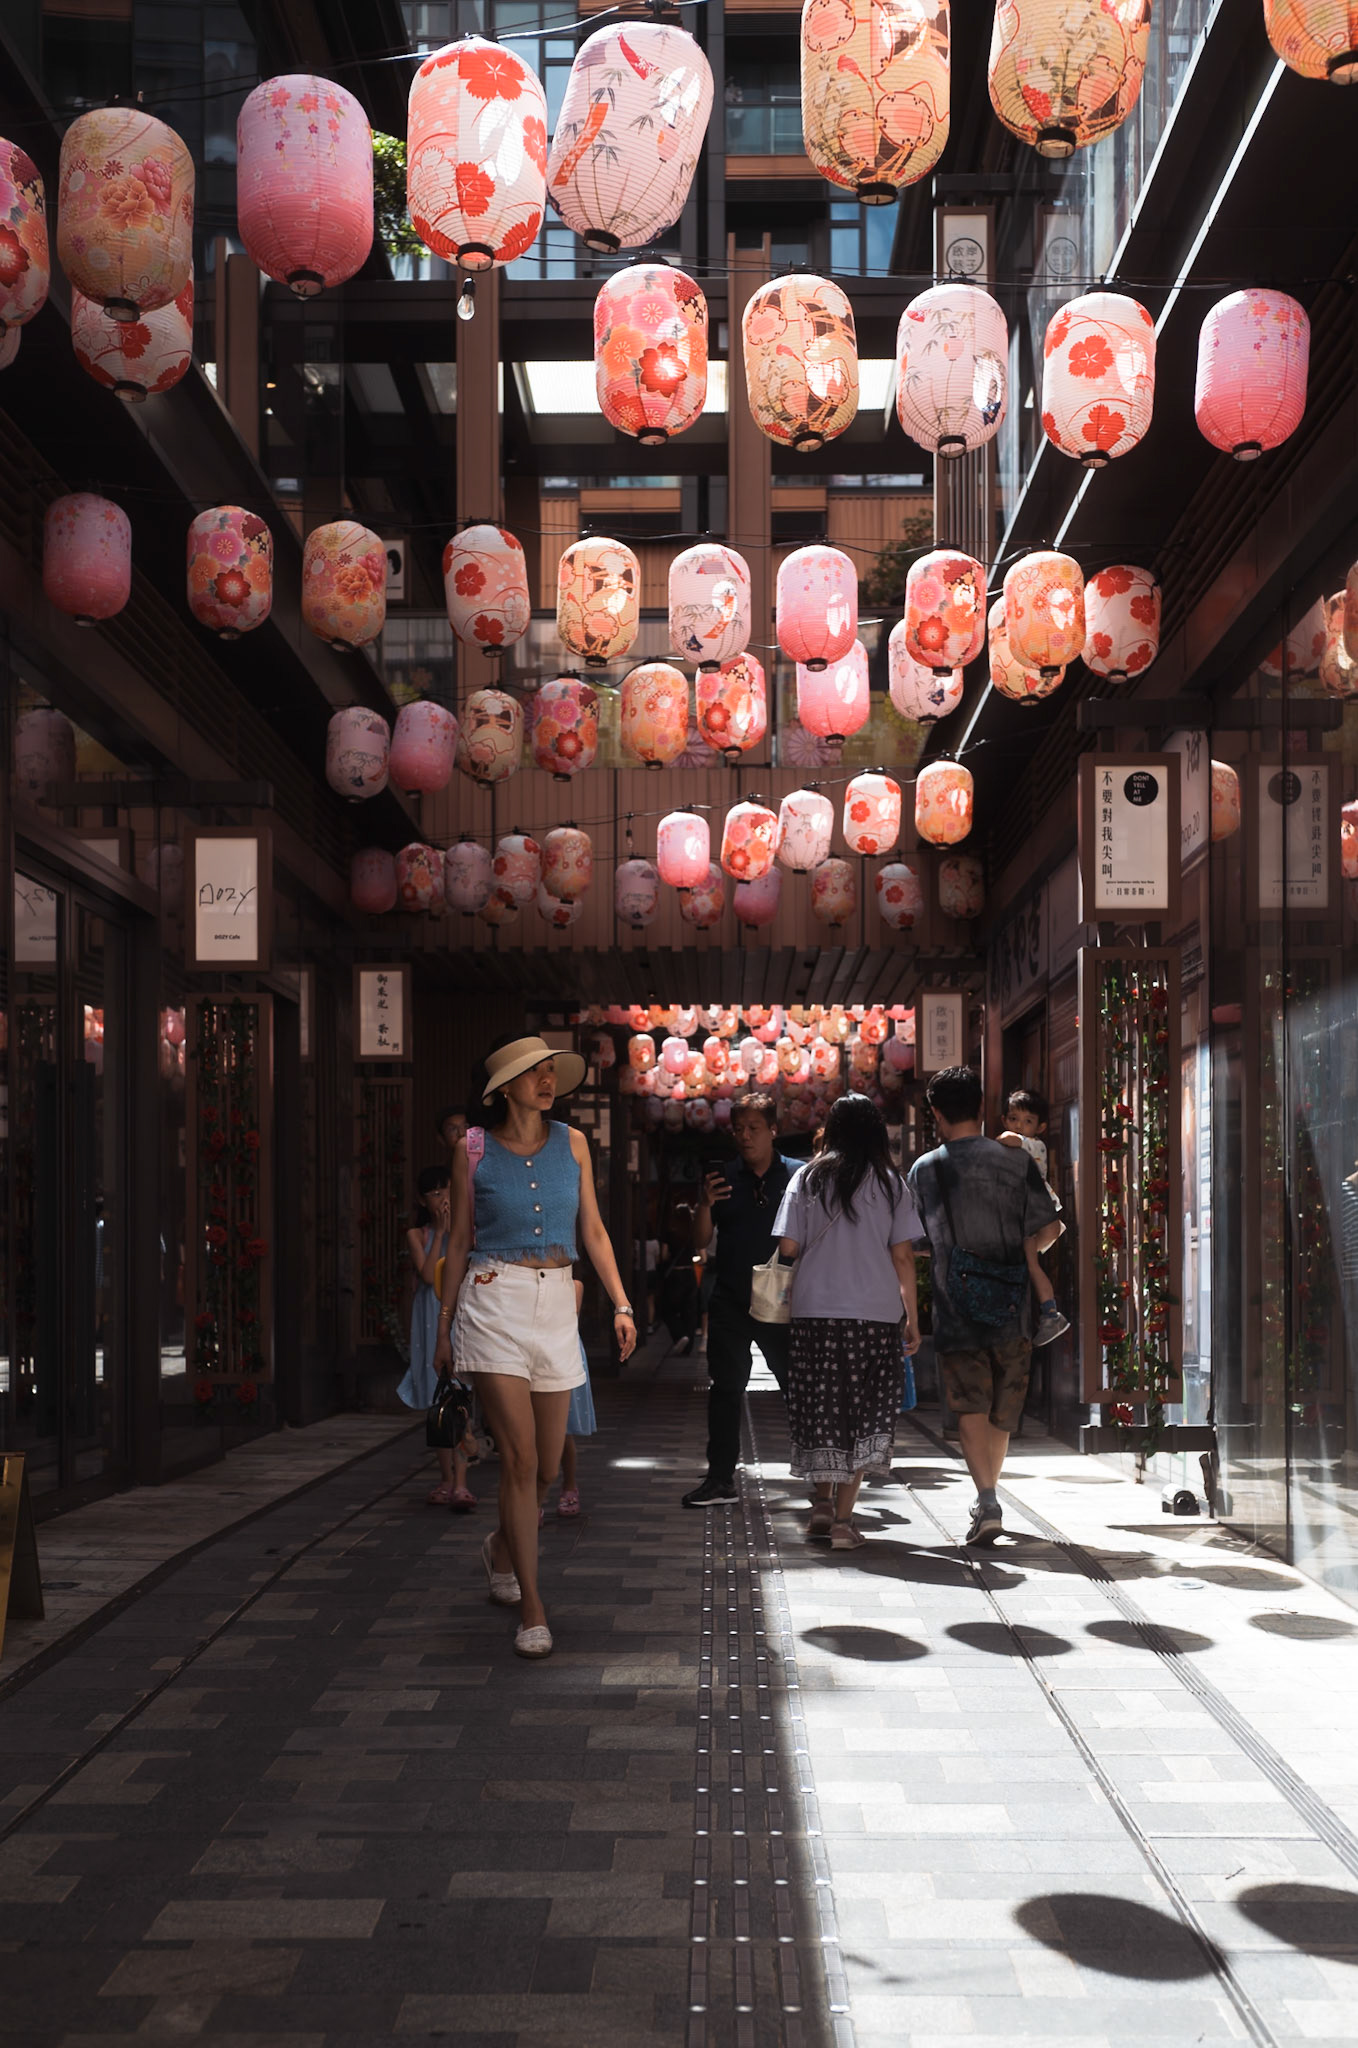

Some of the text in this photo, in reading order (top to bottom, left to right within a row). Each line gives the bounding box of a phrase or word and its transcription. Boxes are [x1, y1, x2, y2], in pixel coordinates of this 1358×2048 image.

[1102, 770, 1113, 879] 不要對我尖叫
